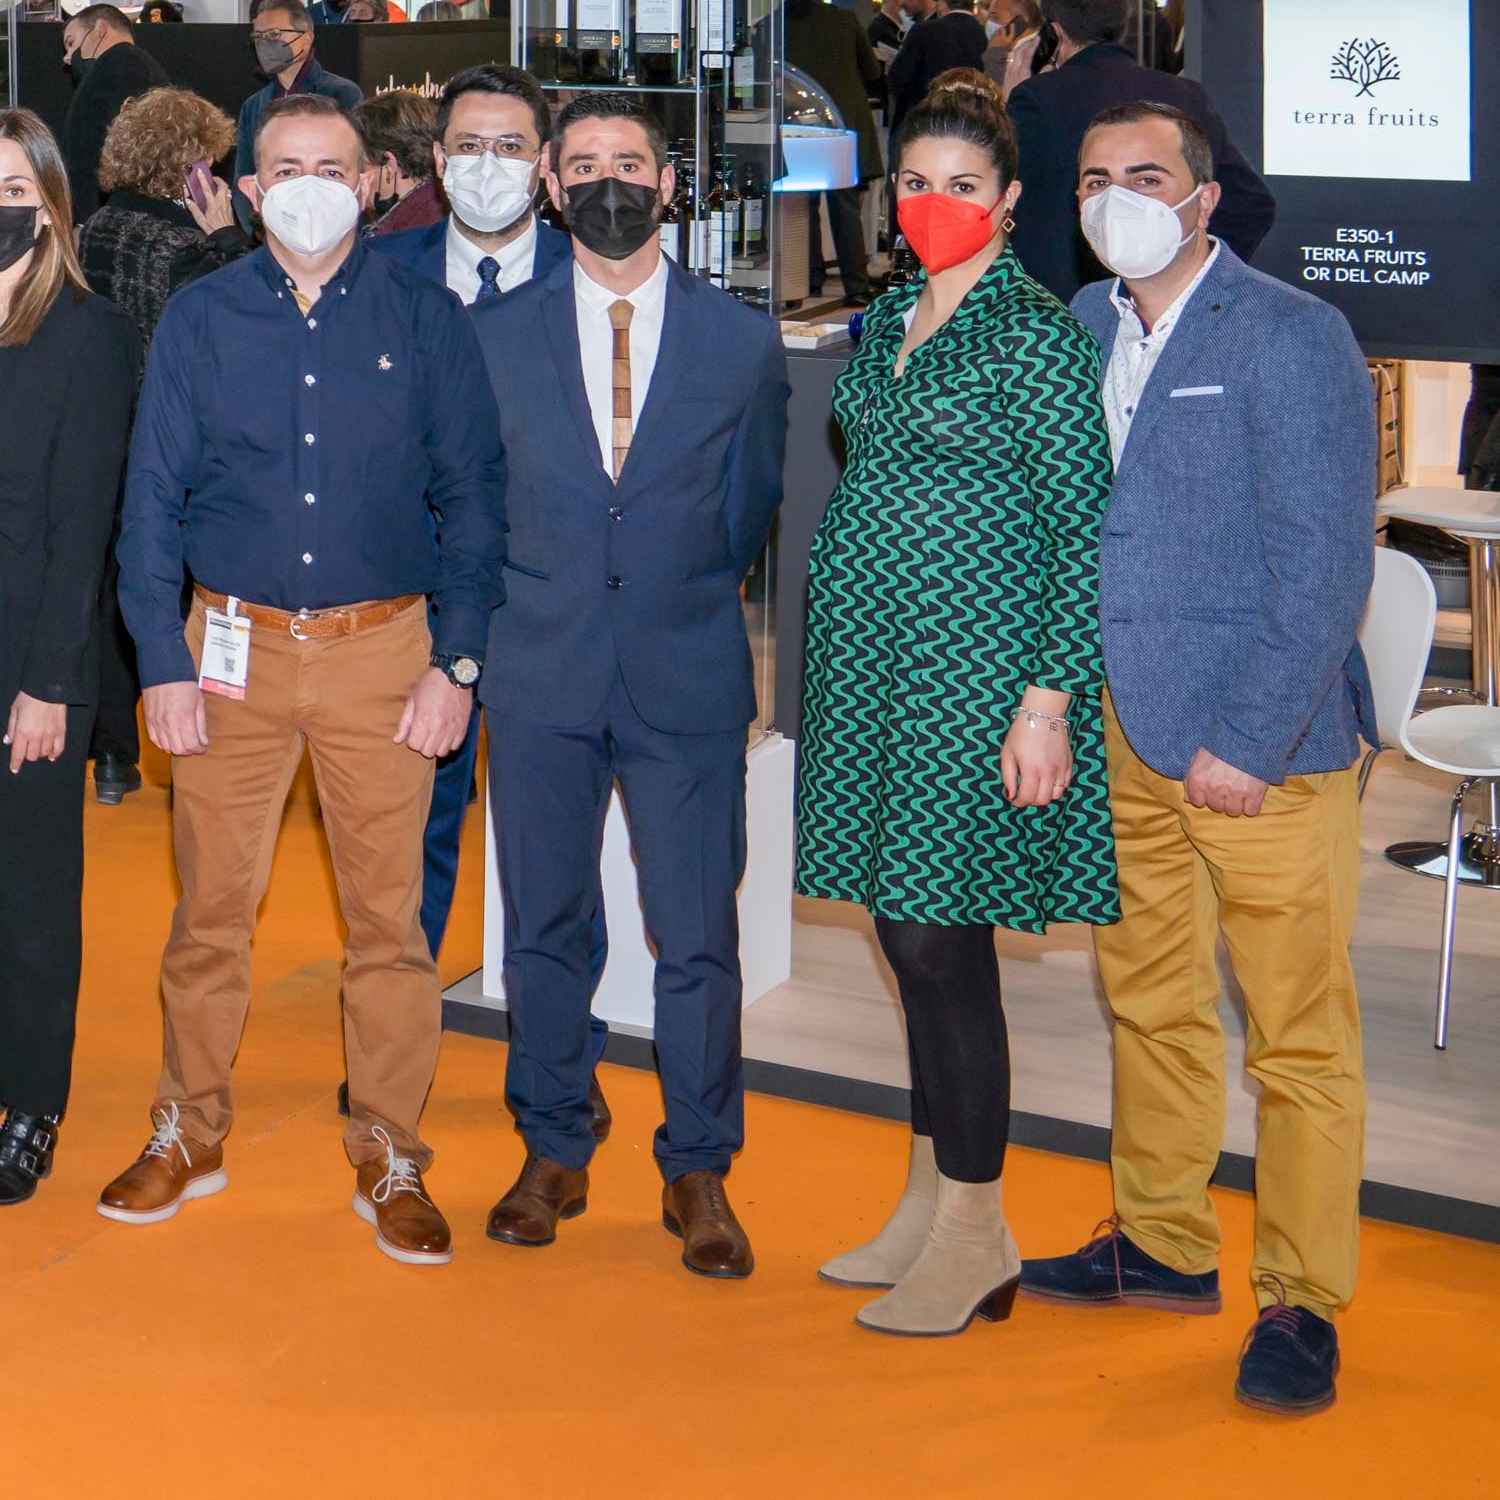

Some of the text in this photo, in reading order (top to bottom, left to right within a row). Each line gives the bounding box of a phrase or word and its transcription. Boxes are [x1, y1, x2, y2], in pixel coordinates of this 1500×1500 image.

[1294, 106, 1440, 127] terra fruits
[1336, 228, 1395, 245] E350-1
[1300, 246, 1427, 266] TERRA FRUITS
[1303, 266, 1431, 286] OR DEL CAMP
